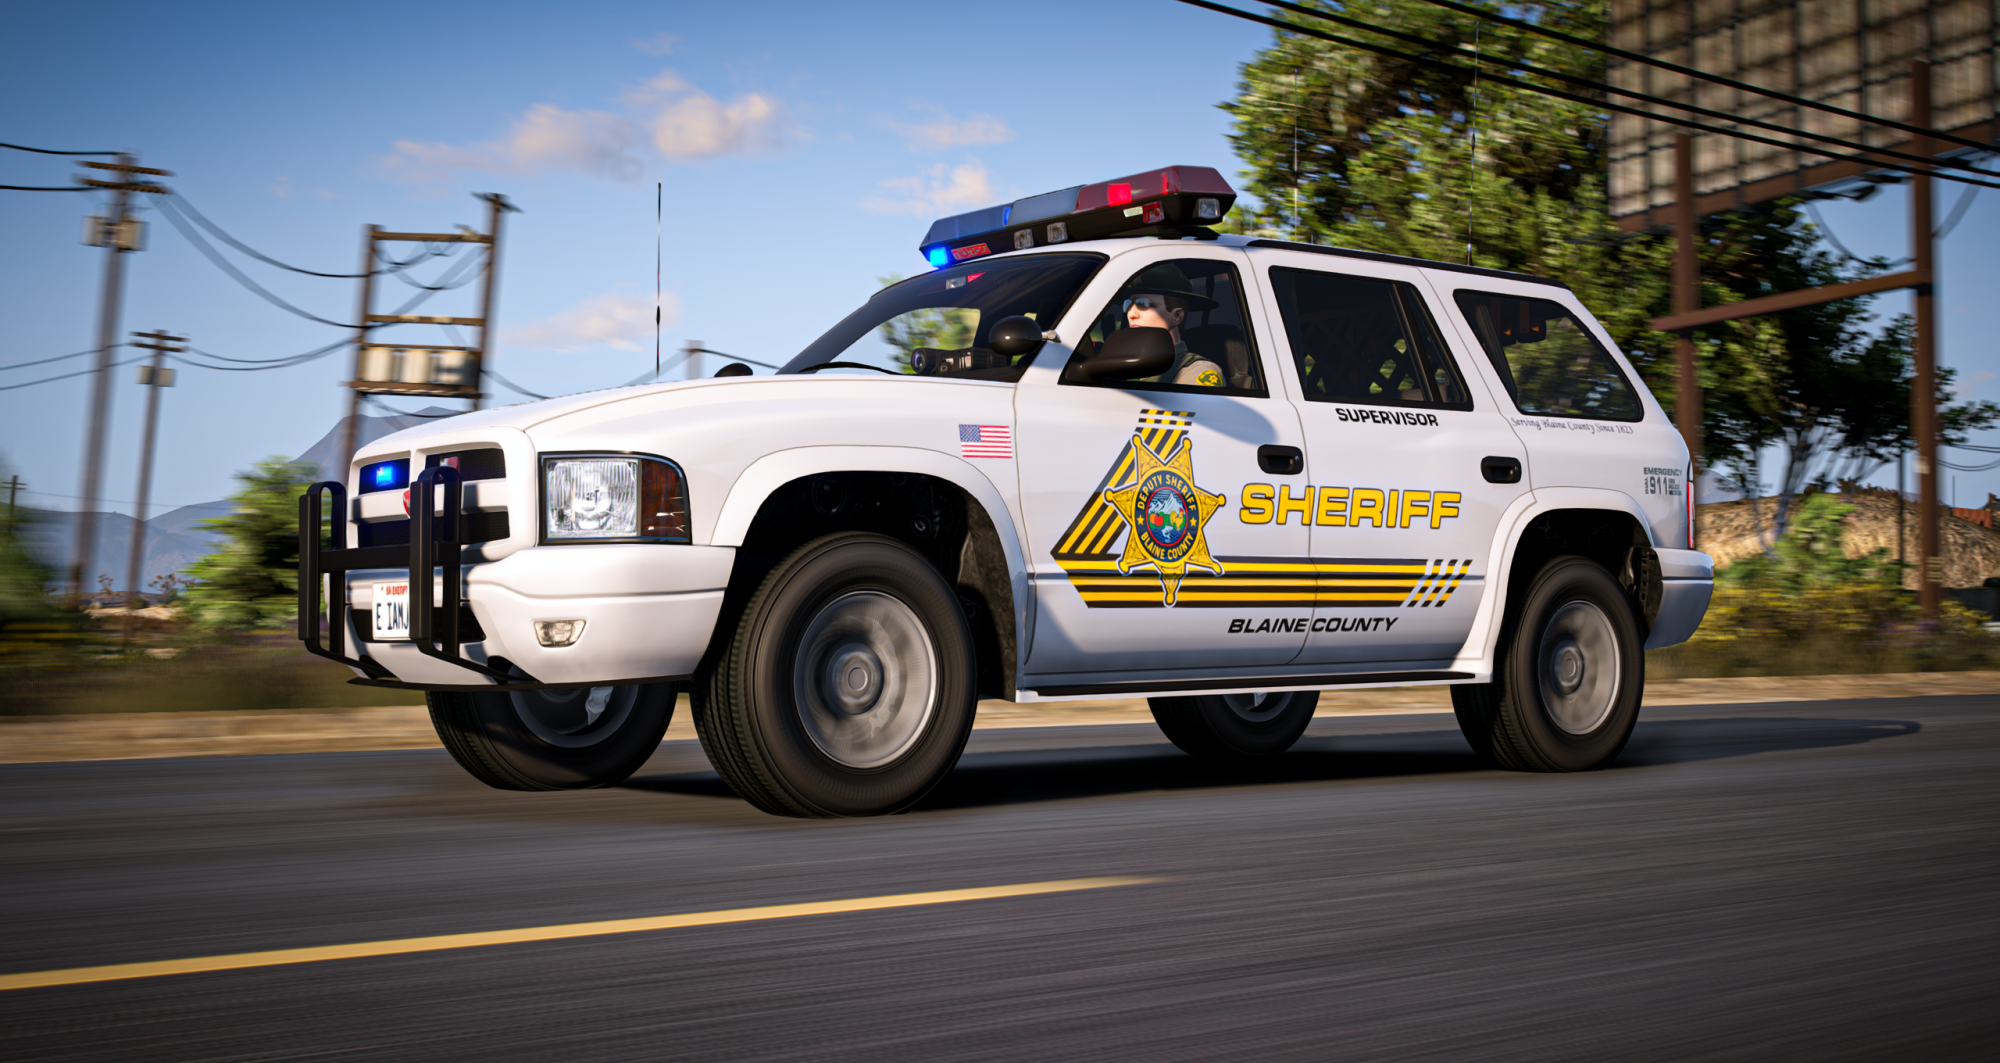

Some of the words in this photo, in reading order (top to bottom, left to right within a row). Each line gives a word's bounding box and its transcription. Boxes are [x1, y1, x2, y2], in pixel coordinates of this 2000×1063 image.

[1335, 407, 1439, 427] SUPERVISOR
[1511, 418, 1542, 431] Serving
[1541, 418, 1567, 429] Blaine
[1567, 421, 1595, 434] County
[1595, 423, 1615, 432] Since
[1643, 467, 1683, 476] EMERGENCY
[1137, 474, 1162, 510] DEPUTY
[1165, 474, 1197, 511] SHERIFF
[1650, 475, 1668, 496] 911
[1239, 482, 1462, 529] SHERIFF
[1140, 531, 1166, 560] BLAINE
[1167, 531, 1194, 560] COUNTY
[376, 602, 382, 630] E
[1227, 618, 1310, 634] BLAINE
[1310, 617, 1399, 633] COUNTY
